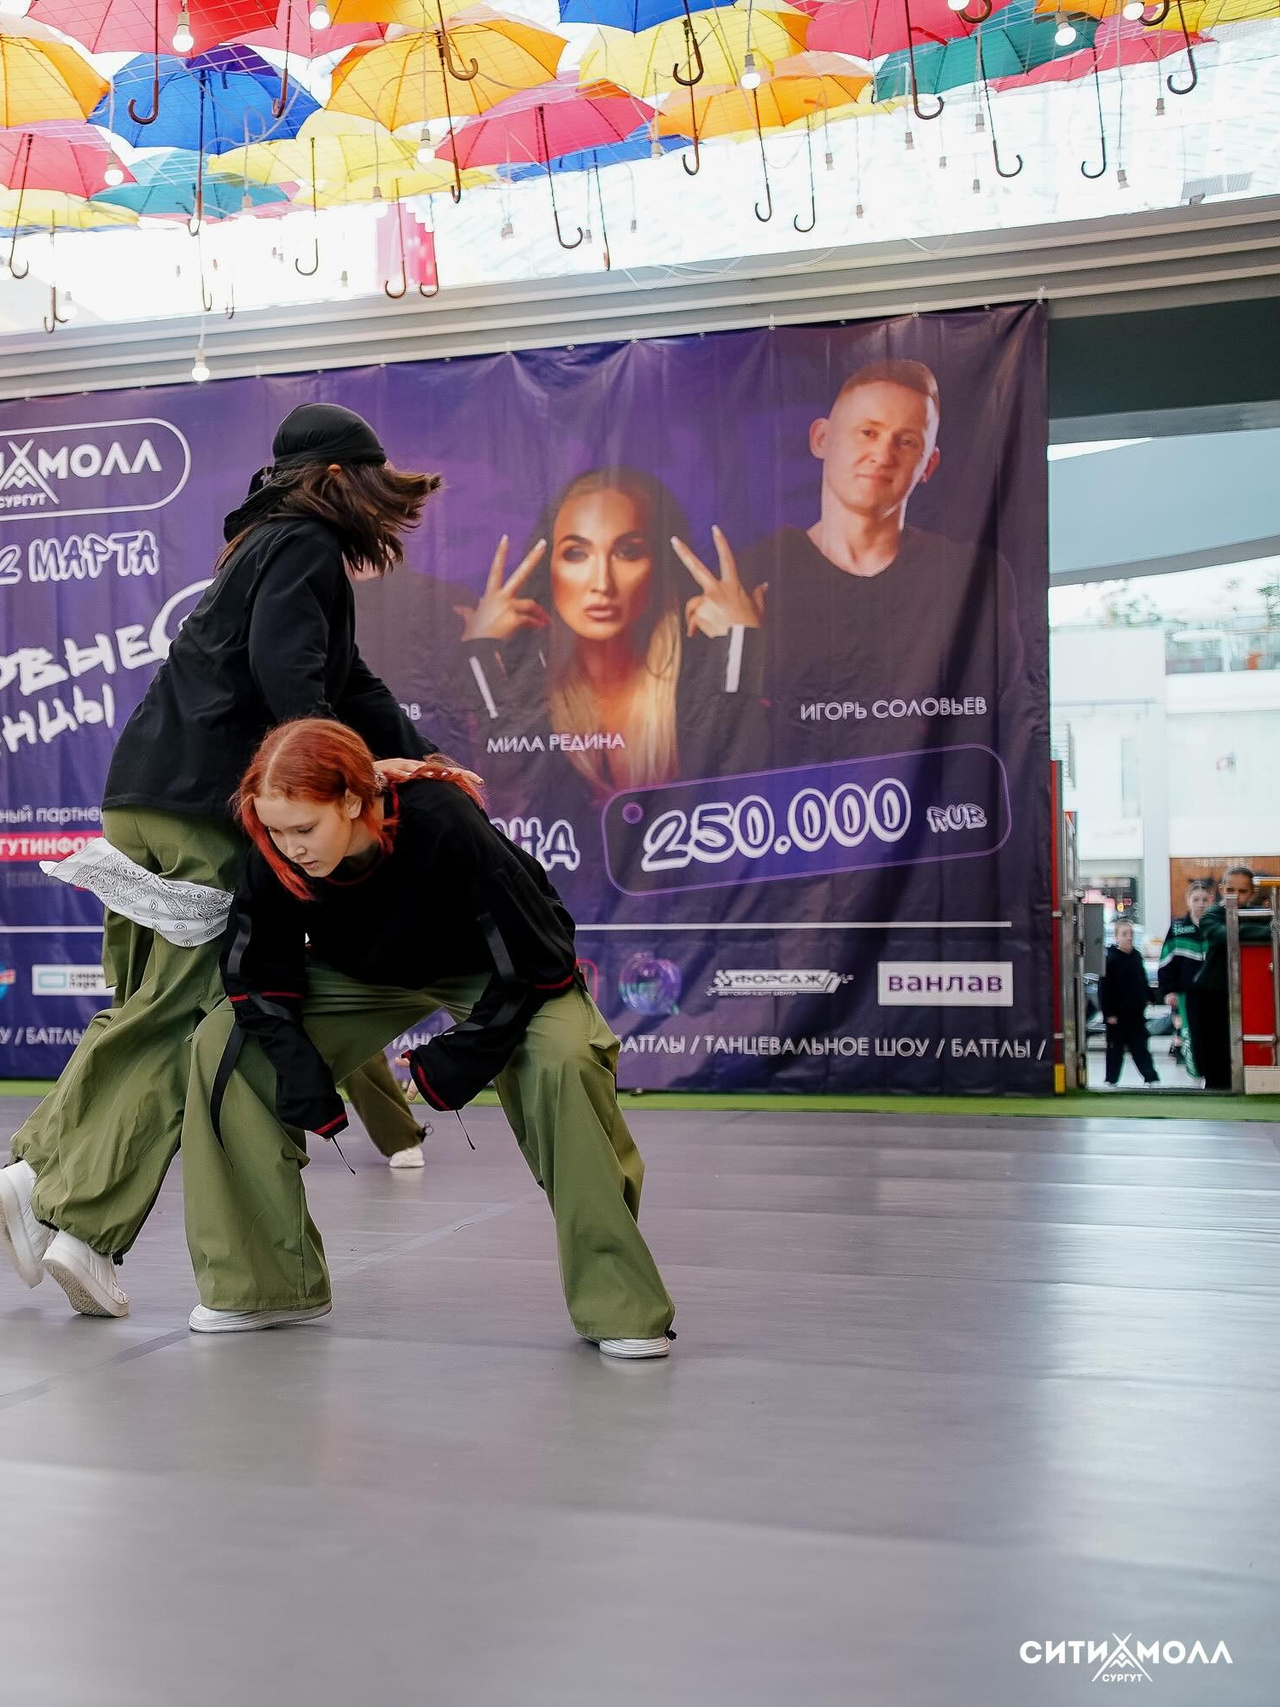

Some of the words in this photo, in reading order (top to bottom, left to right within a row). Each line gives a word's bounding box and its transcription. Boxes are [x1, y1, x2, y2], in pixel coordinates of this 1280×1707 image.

[28, 529, 160, 583] МАРТА
[800, 701, 867, 721] ИГОРЬ
[871, 696, 987, 719] СОЛОВЬЕВ
[487, 734, 546, 753] МИЛА
[548, 732, 626, 751] РЕДИНА
[641, 777, 912, 872] 250.000
[926, 802, 988, 833] RUB
[734, 974, 822, 985] ФОРСАЖ
[888, 975, 1003, 992] ванлав
[703, 1034, 869, 1057] ТАНЦЕВАЛЬНОЕ
[875, 1036, 930, 1057] ШОУ
[951, 1038, 1031, 1059] БАТТЛЫ
